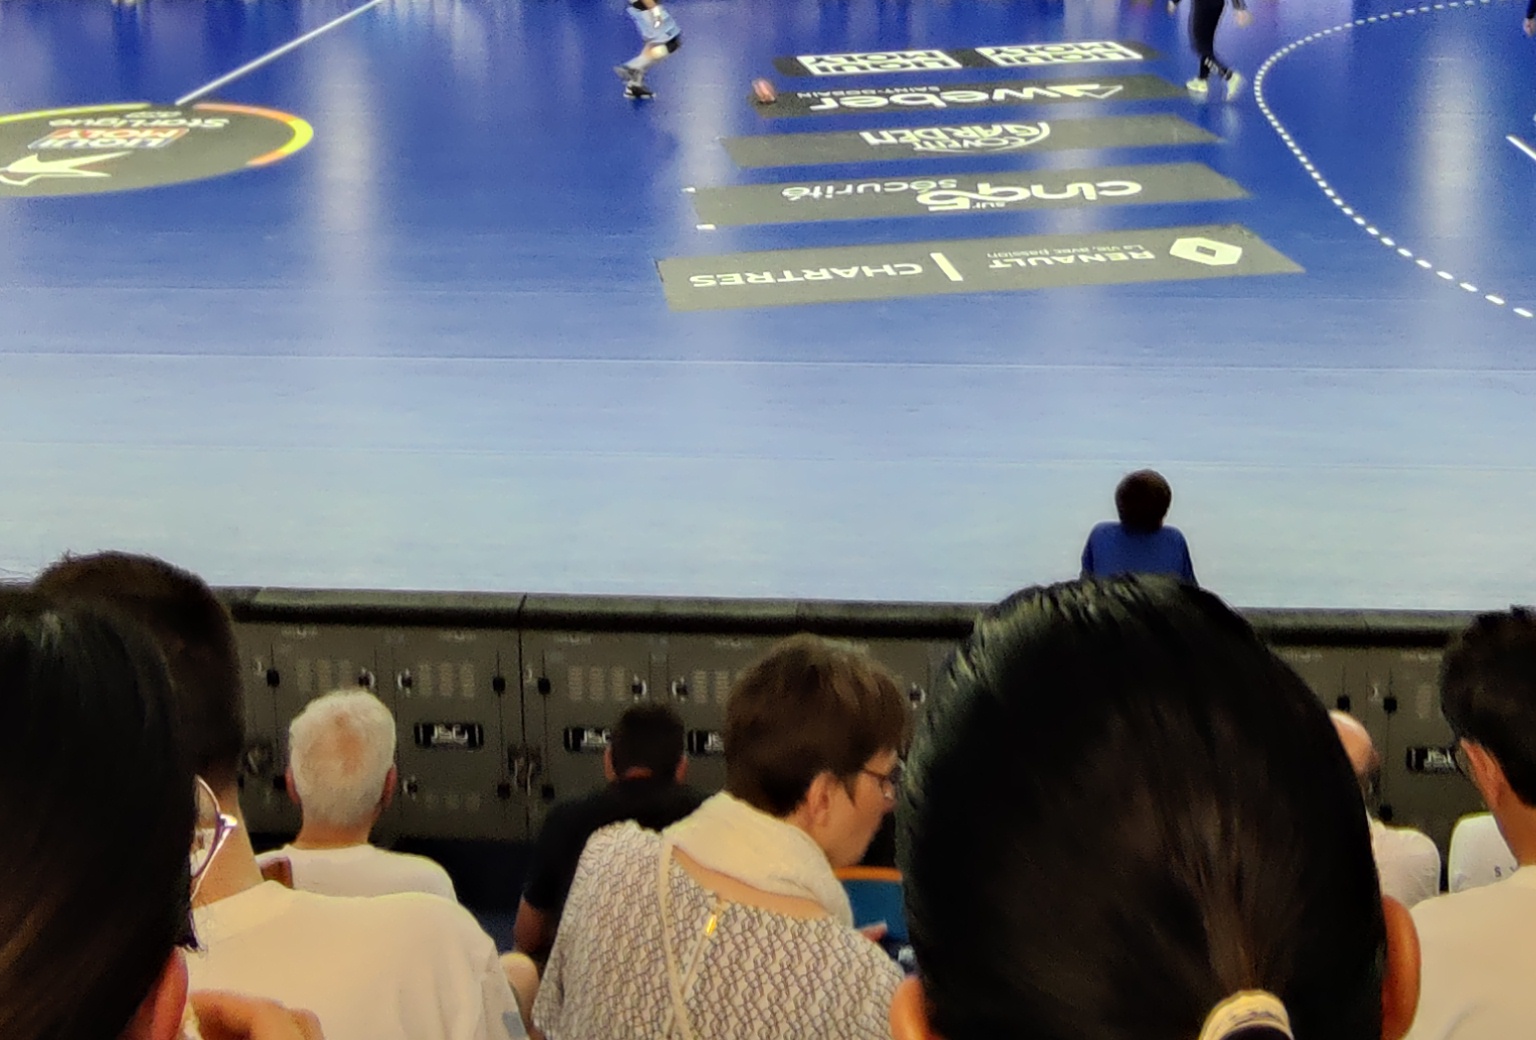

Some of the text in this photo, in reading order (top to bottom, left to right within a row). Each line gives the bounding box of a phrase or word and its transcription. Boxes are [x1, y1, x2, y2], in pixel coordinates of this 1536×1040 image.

[810, 86, 1062, 110] weber
[782, 178, 958, 201] sécurité
[988, 250, 1156, 270] RENAULT
[689, 262, 924, 288] CHARTRES
